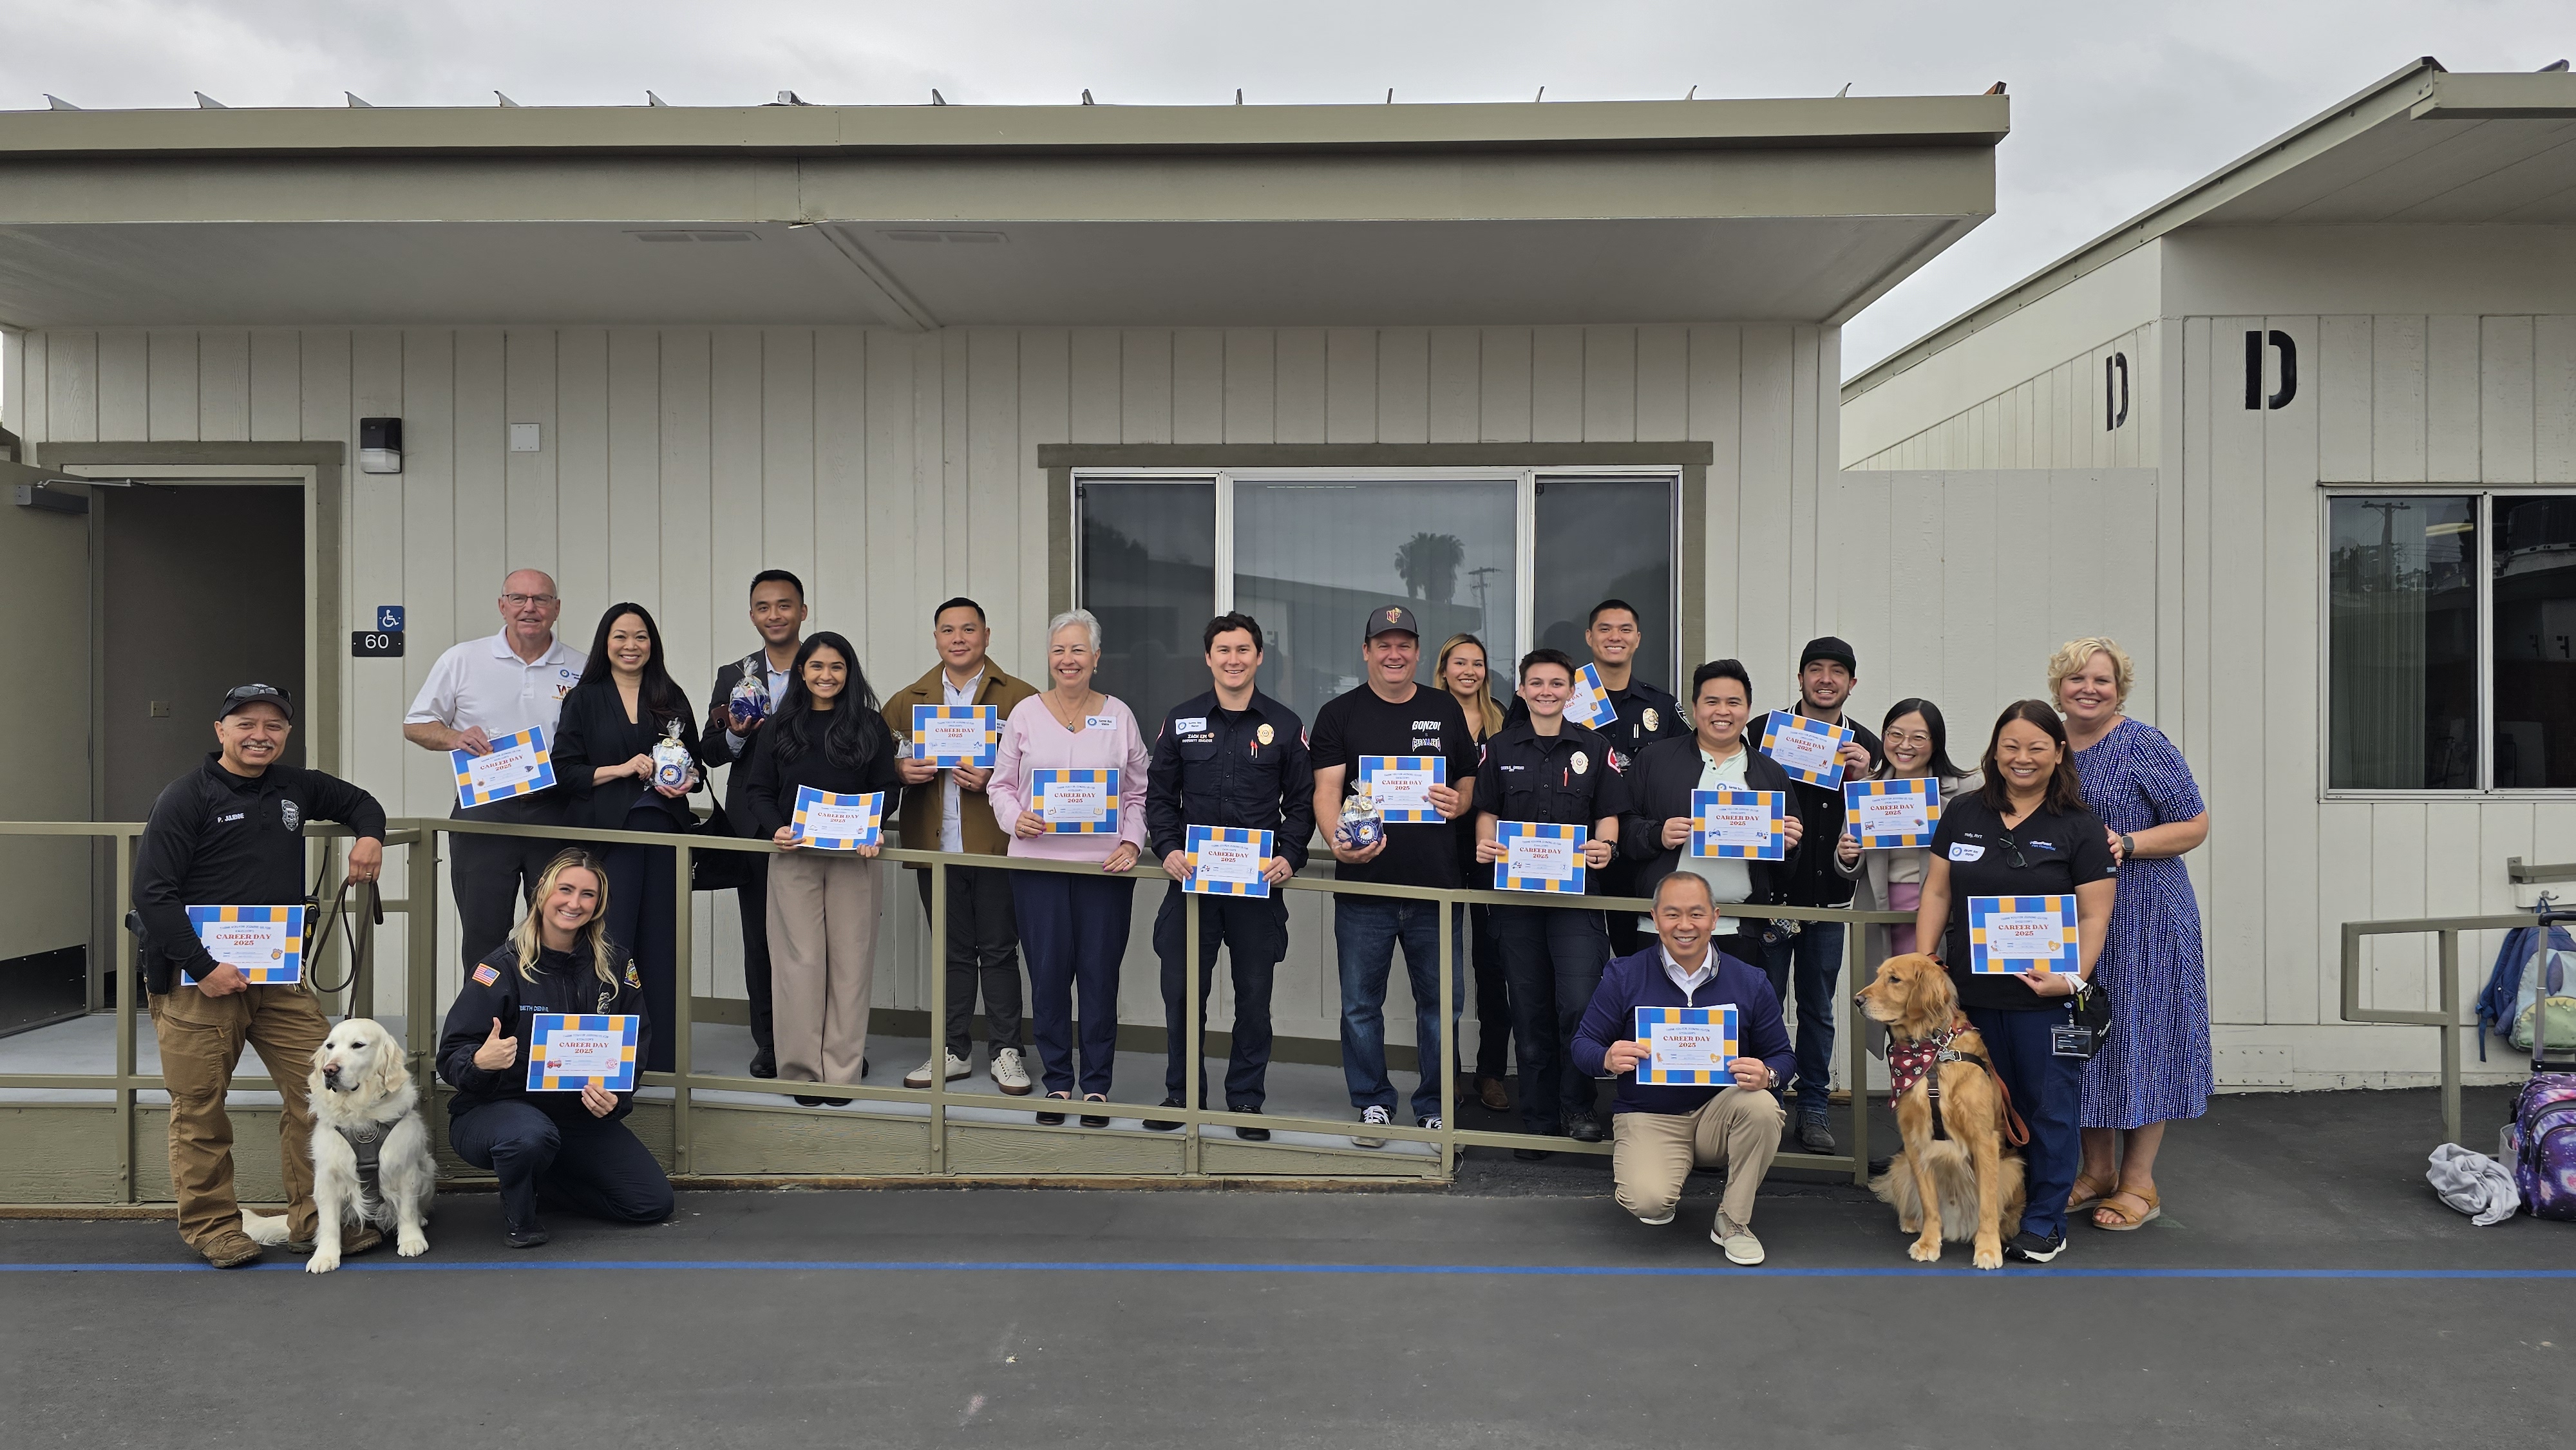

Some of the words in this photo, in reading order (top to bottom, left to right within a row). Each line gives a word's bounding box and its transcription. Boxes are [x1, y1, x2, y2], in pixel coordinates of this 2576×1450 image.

[2245, 330, 2297, 410] D
[2106, 352, 2128, 431] D
[365, 634, 389, 649] 60
[1786, 736, 1812, 747] CAREER
[480, 760, 508, 769] CAREER
[495, 763, 511, 771] 2025
